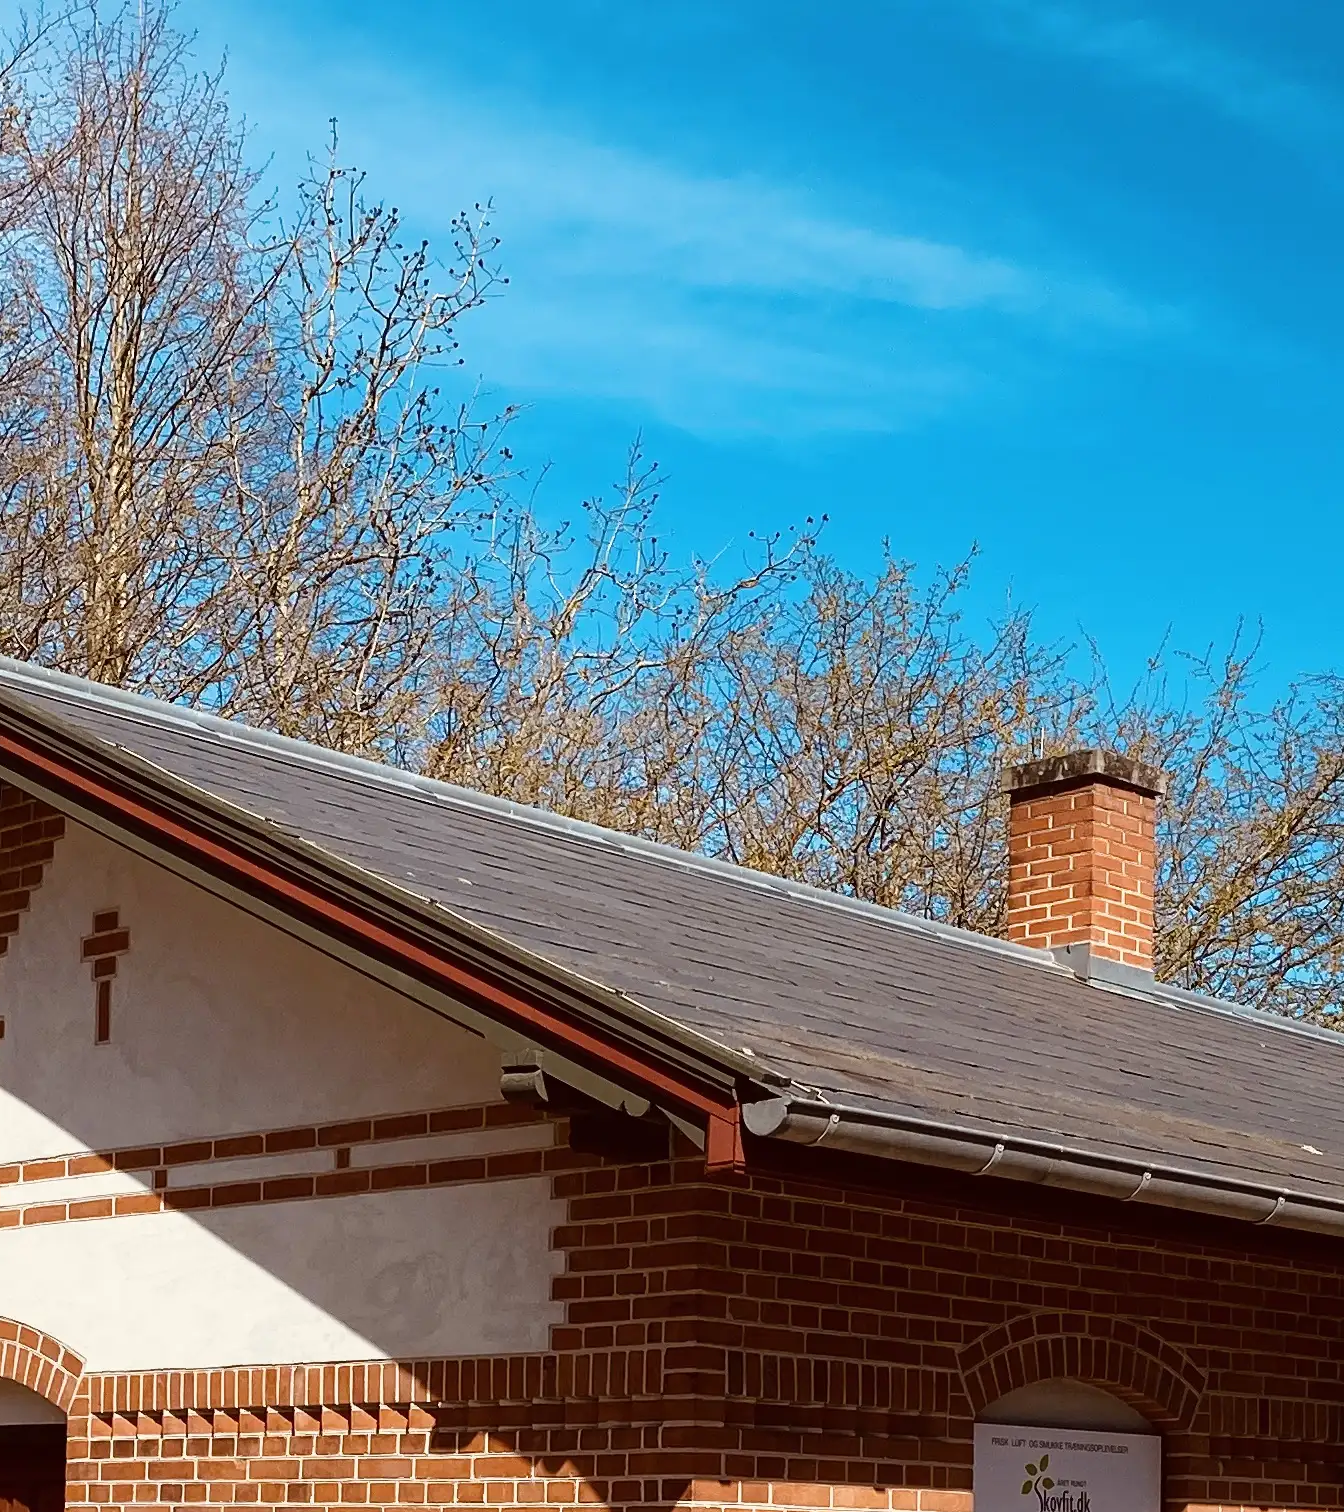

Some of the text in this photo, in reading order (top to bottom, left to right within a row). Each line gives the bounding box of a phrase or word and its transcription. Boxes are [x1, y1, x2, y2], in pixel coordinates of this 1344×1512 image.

[991, 1437, 1009, 1447] FRISK
[1011, 1439, 1026, 1448] LUFT
[1029, 1440, 1038, 1449] OG
[1039, 1440, 1064, 1451] SMUKKE
